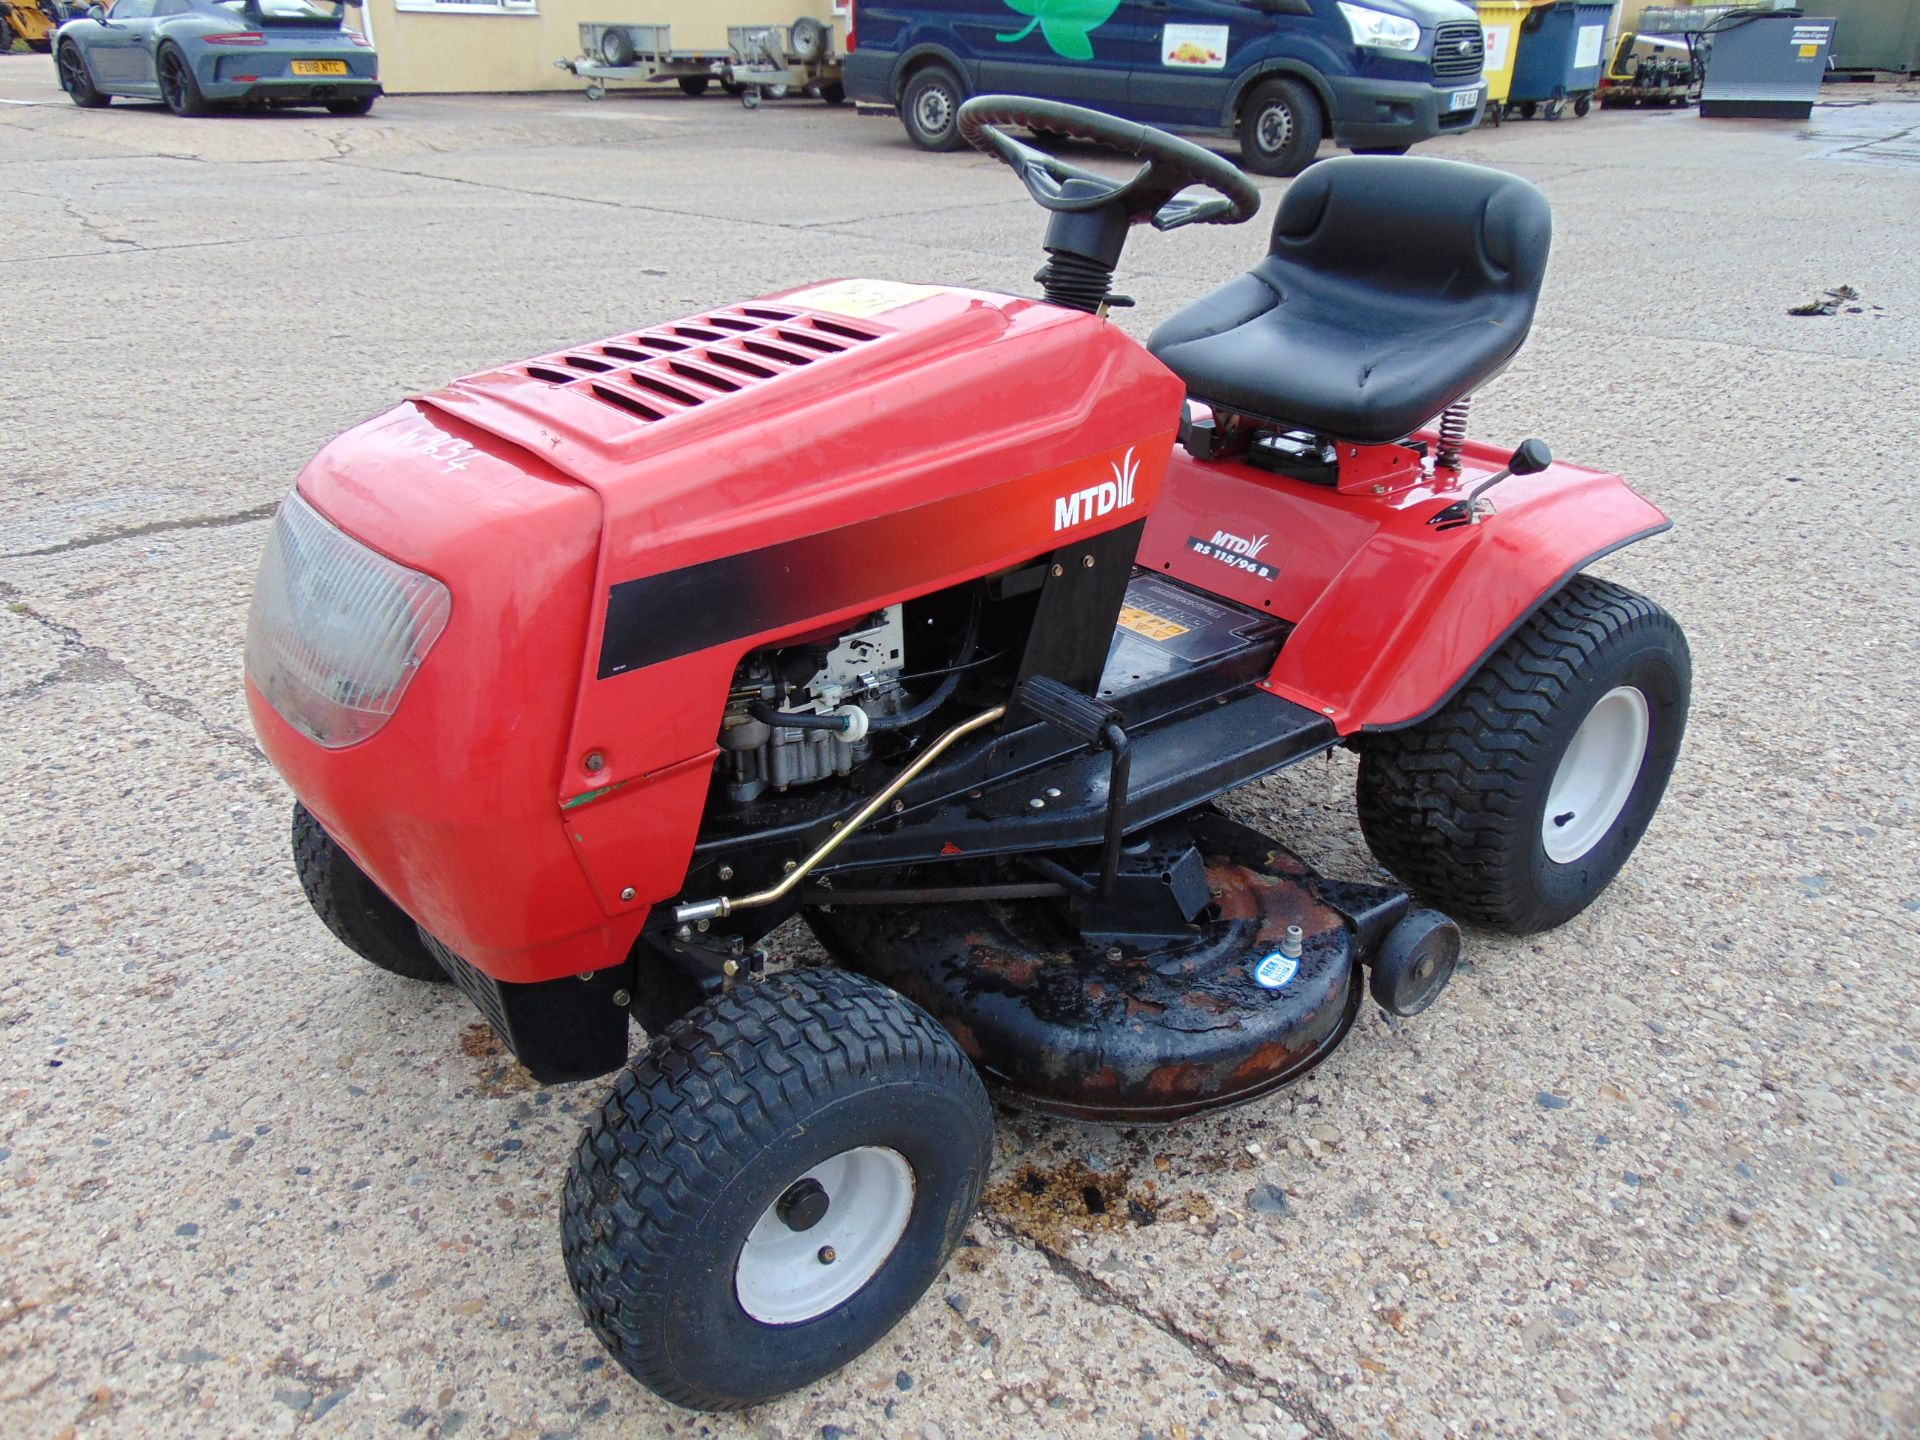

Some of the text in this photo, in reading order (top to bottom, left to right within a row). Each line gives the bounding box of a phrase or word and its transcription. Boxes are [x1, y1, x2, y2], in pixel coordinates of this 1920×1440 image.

[1055, 481, 1117, 531] MTD
[1193, 542, 1269, 577] RS 115/96 B
[1210, 530, 1250, 554] MTD
